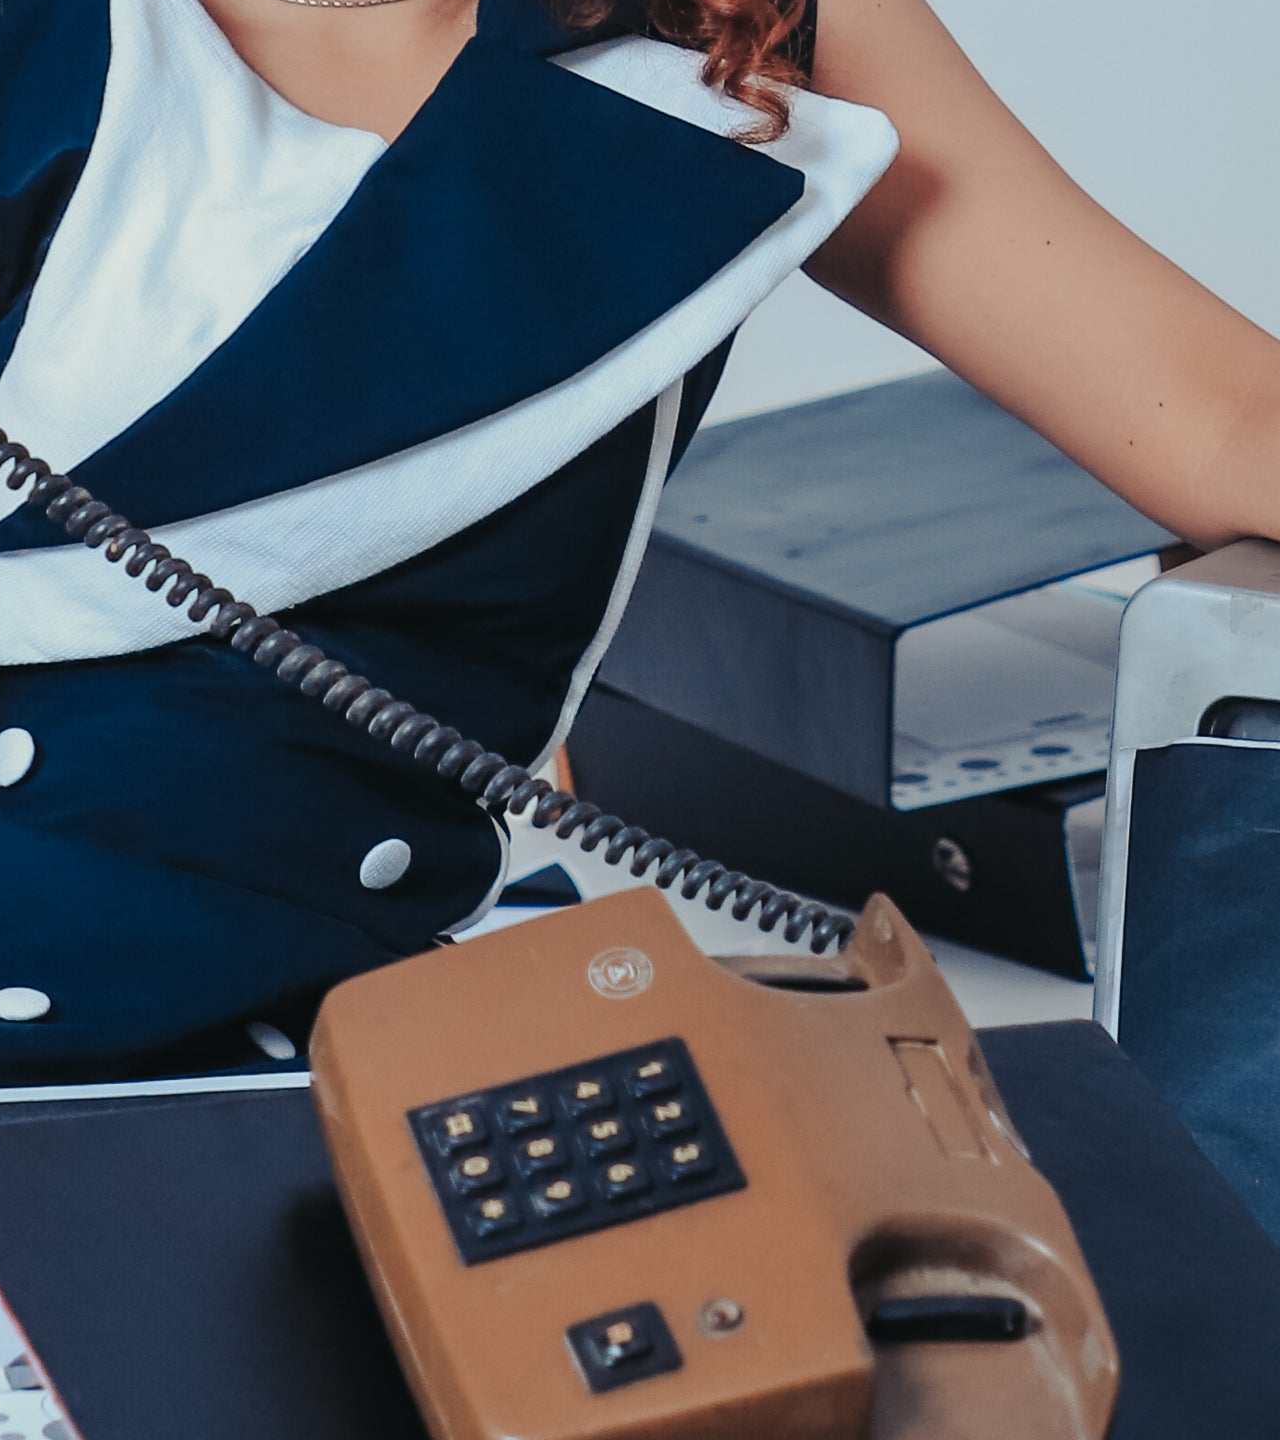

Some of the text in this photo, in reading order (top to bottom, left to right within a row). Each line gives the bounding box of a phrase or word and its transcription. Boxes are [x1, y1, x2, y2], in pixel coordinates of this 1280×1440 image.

[511, 1097, 572, 1199] 7 8 9
[576, 1081, 634, 1183] 4 5 6
[638, 1061, 699, 1163] 1 2 3
